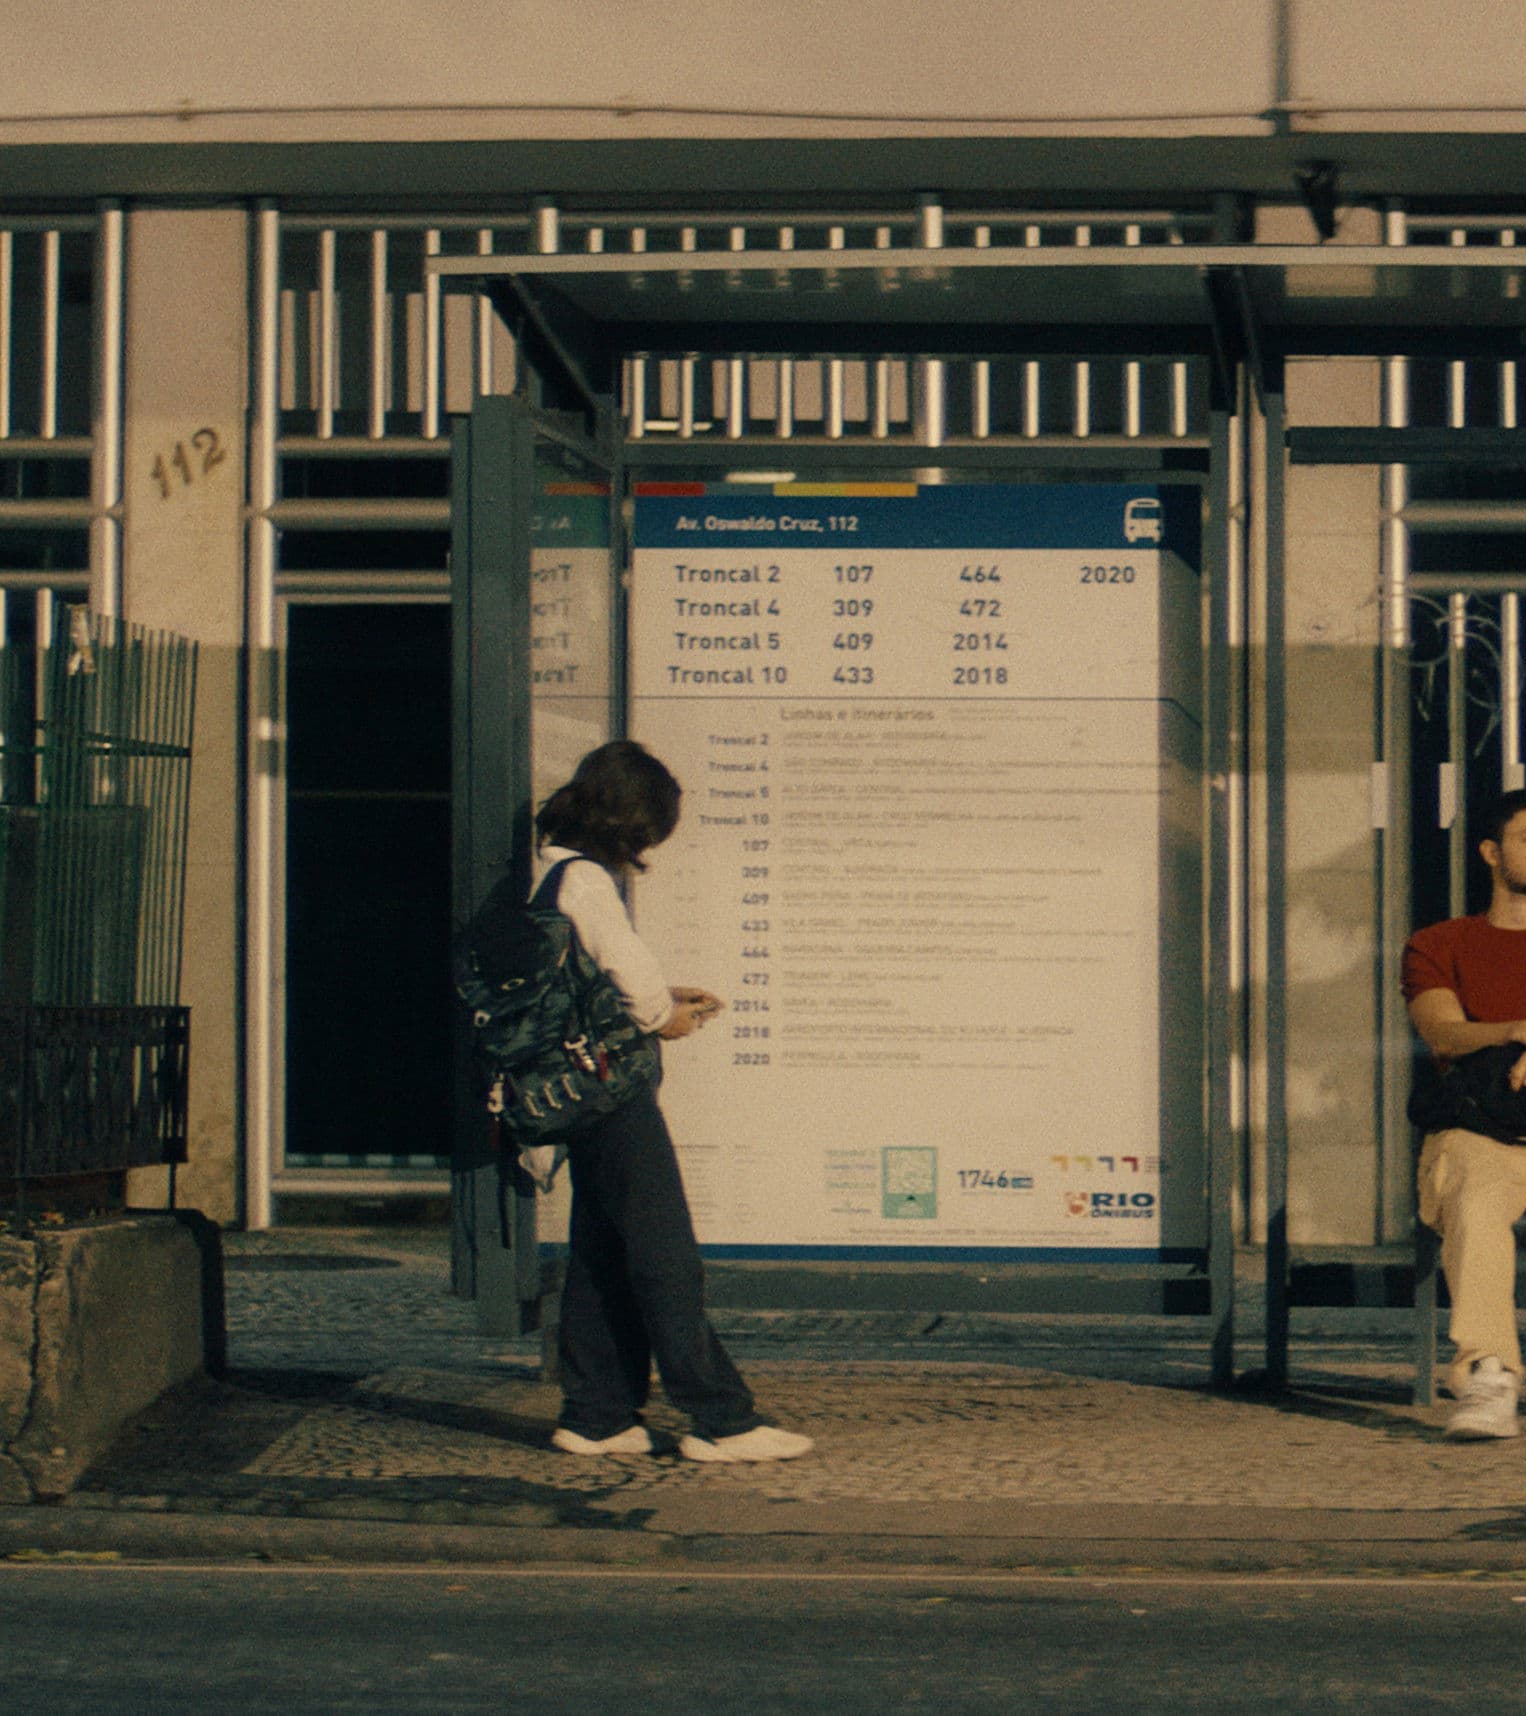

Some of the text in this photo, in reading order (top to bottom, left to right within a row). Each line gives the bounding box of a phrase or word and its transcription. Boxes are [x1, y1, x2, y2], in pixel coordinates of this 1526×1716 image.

[151, 427, 225, 499] 112
[675, 515, 859, 533] Av. Oswaldo Cruz, 112
[674, 564, 781, 584] Troncal 2
[834, 564, 874, 584] 107
[959, 565, 1001, 584] 464
[1080, 565, 1136, 584] 2020
[674, 597, 781, 617] Troncal 4
[833, 598, 874, 617] 309
[959, 598, 1001, 618] 472
[673, 631, 781, 651] Troncal 5
[832, 632, 874, 651] 409
[953, 632, 1009, 652] 2014
[666, 665, 788, 685] Troncal 10
[832, 666, 875, 685] 433
[952, 666, 1009, 686] 2018
[780, 707, 834, 721] Linhas
[759, 732, 770, 746] 2
[759, 760, 770, 772] 4
[759, 785, 770, 799] 5
[751, 812, 770, 826] 10
[957, 1169, 1008, 1189] 1746
[1091, 1192, 1156, 1208] RIO
